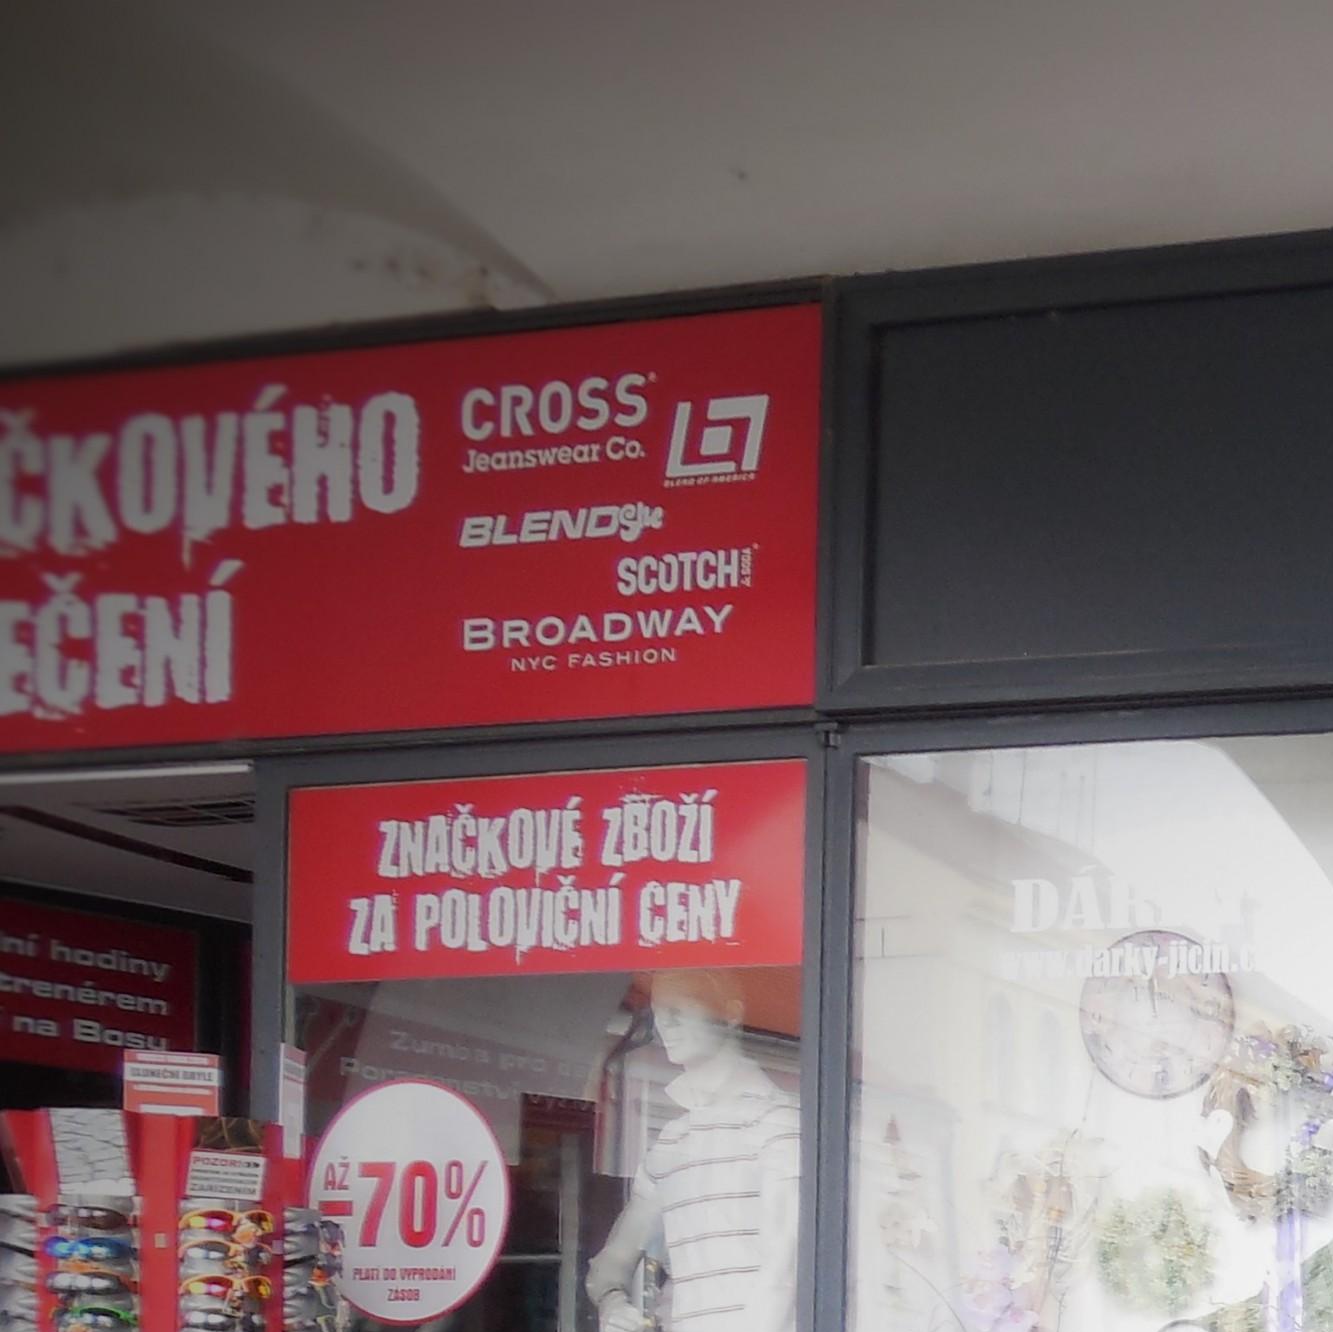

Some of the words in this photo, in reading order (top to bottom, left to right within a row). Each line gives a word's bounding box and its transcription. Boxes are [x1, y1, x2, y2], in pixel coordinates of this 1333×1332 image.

[462, 444, 602, 473] Jeanswear
[605, 436, 646, 461] Co.
[617, 549, 740, 596] SCOTCH
[463, 604, 734, 650] BROADWAY
[511, 654, 557, 672] NYC
[568, 648, 677, 669] FASHION
[377, 796, 582, 880] ZNAČKOVÉ
[600, 789, 718, 867] ZBOŽÍ
[348, 893, 397, 955] ZA
[414, 872, 626, 957] POLOVIČNÍ
[637, 879, 742, 948] CENY
[49, 938, 171, 982] hodiny
[13, 1014, 59, 1037] na
[323, 1156, 350, 1191] AŽ
